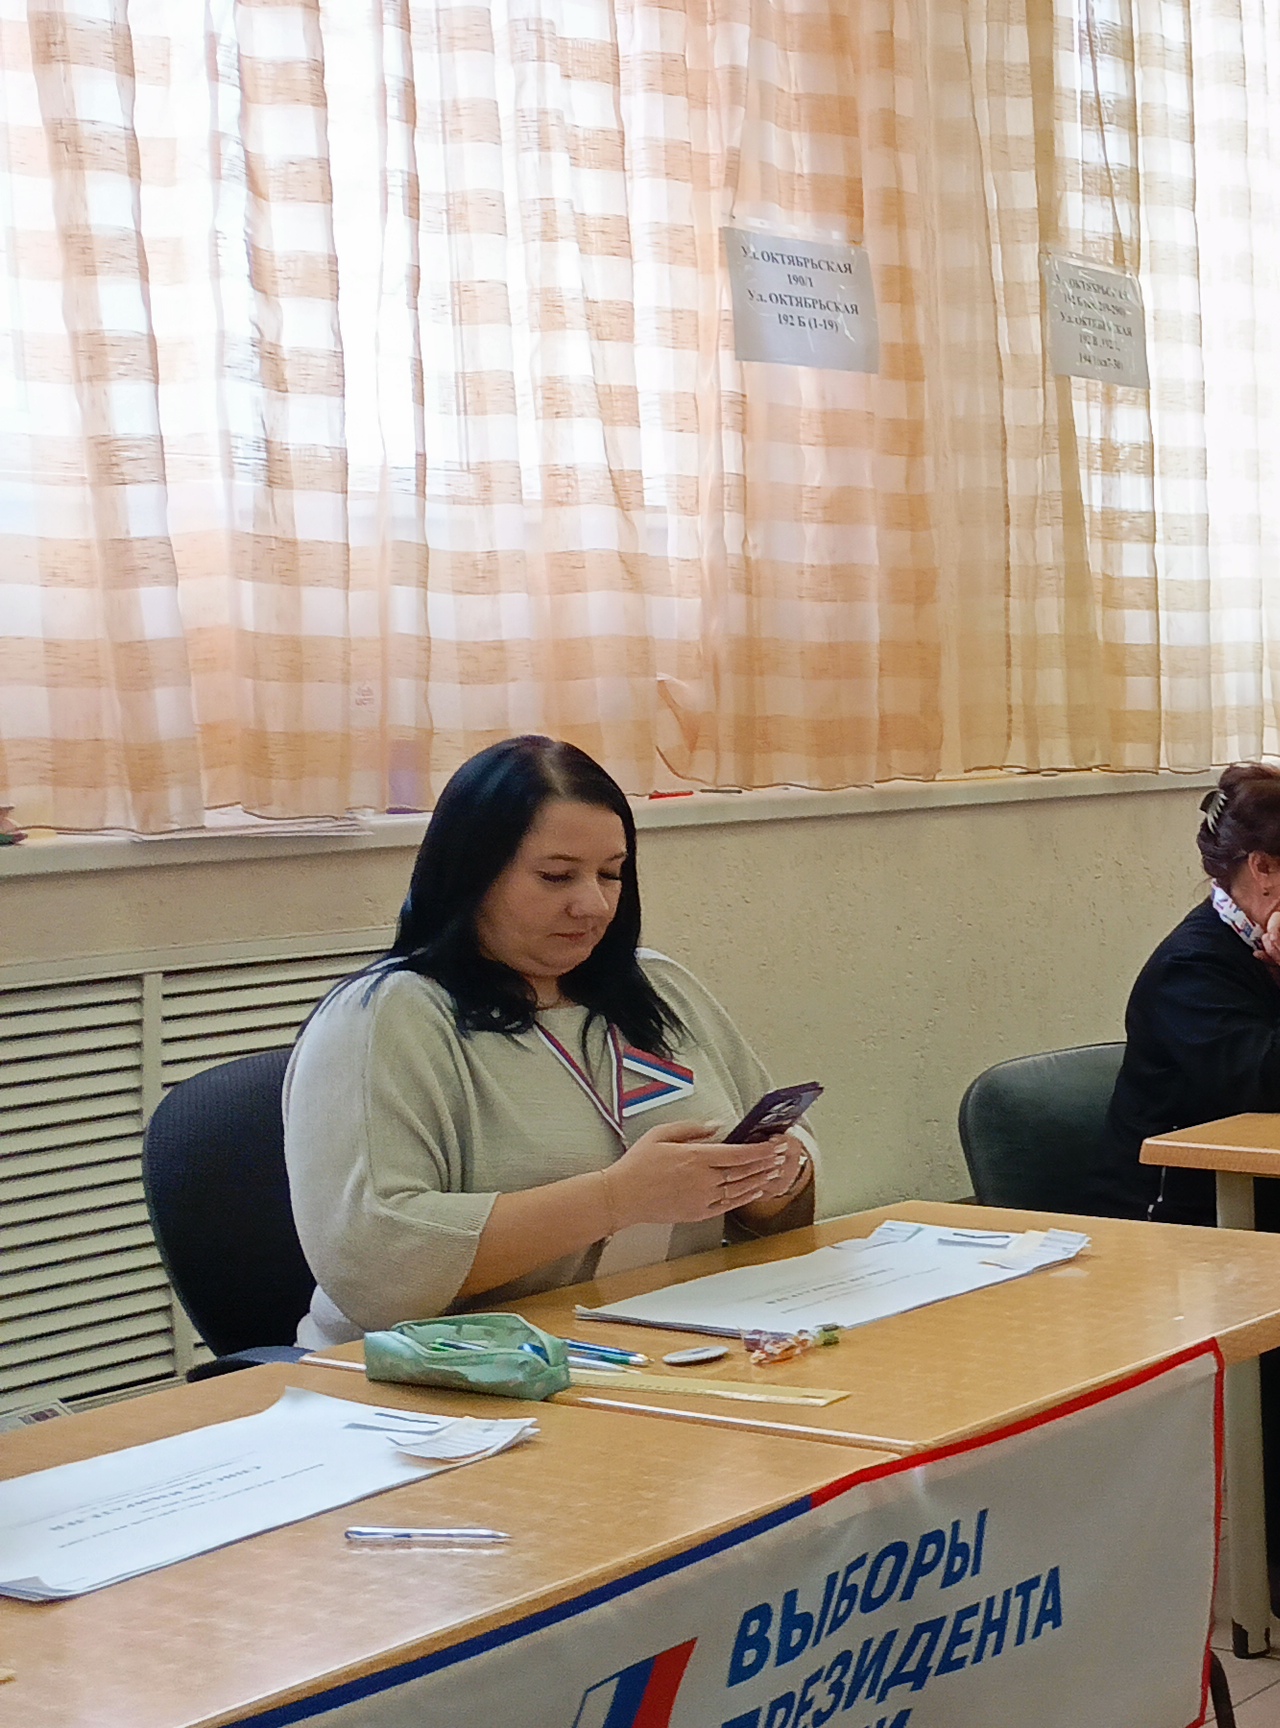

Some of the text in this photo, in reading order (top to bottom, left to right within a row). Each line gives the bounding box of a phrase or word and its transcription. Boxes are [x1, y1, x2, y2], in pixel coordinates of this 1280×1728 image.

[762, 251, 853, 275] ОКТЯБРЬСКАЯ
[787, 273, 814, 288] 190/1
[769, 292, 859, 315] ОКТЯБРЬСКАЯ
[778, 313, 795, 326] 192
[808, 318, 839, 332] (1-19)
[726, 1508, 989, 1688] ВЫБОРЫ
